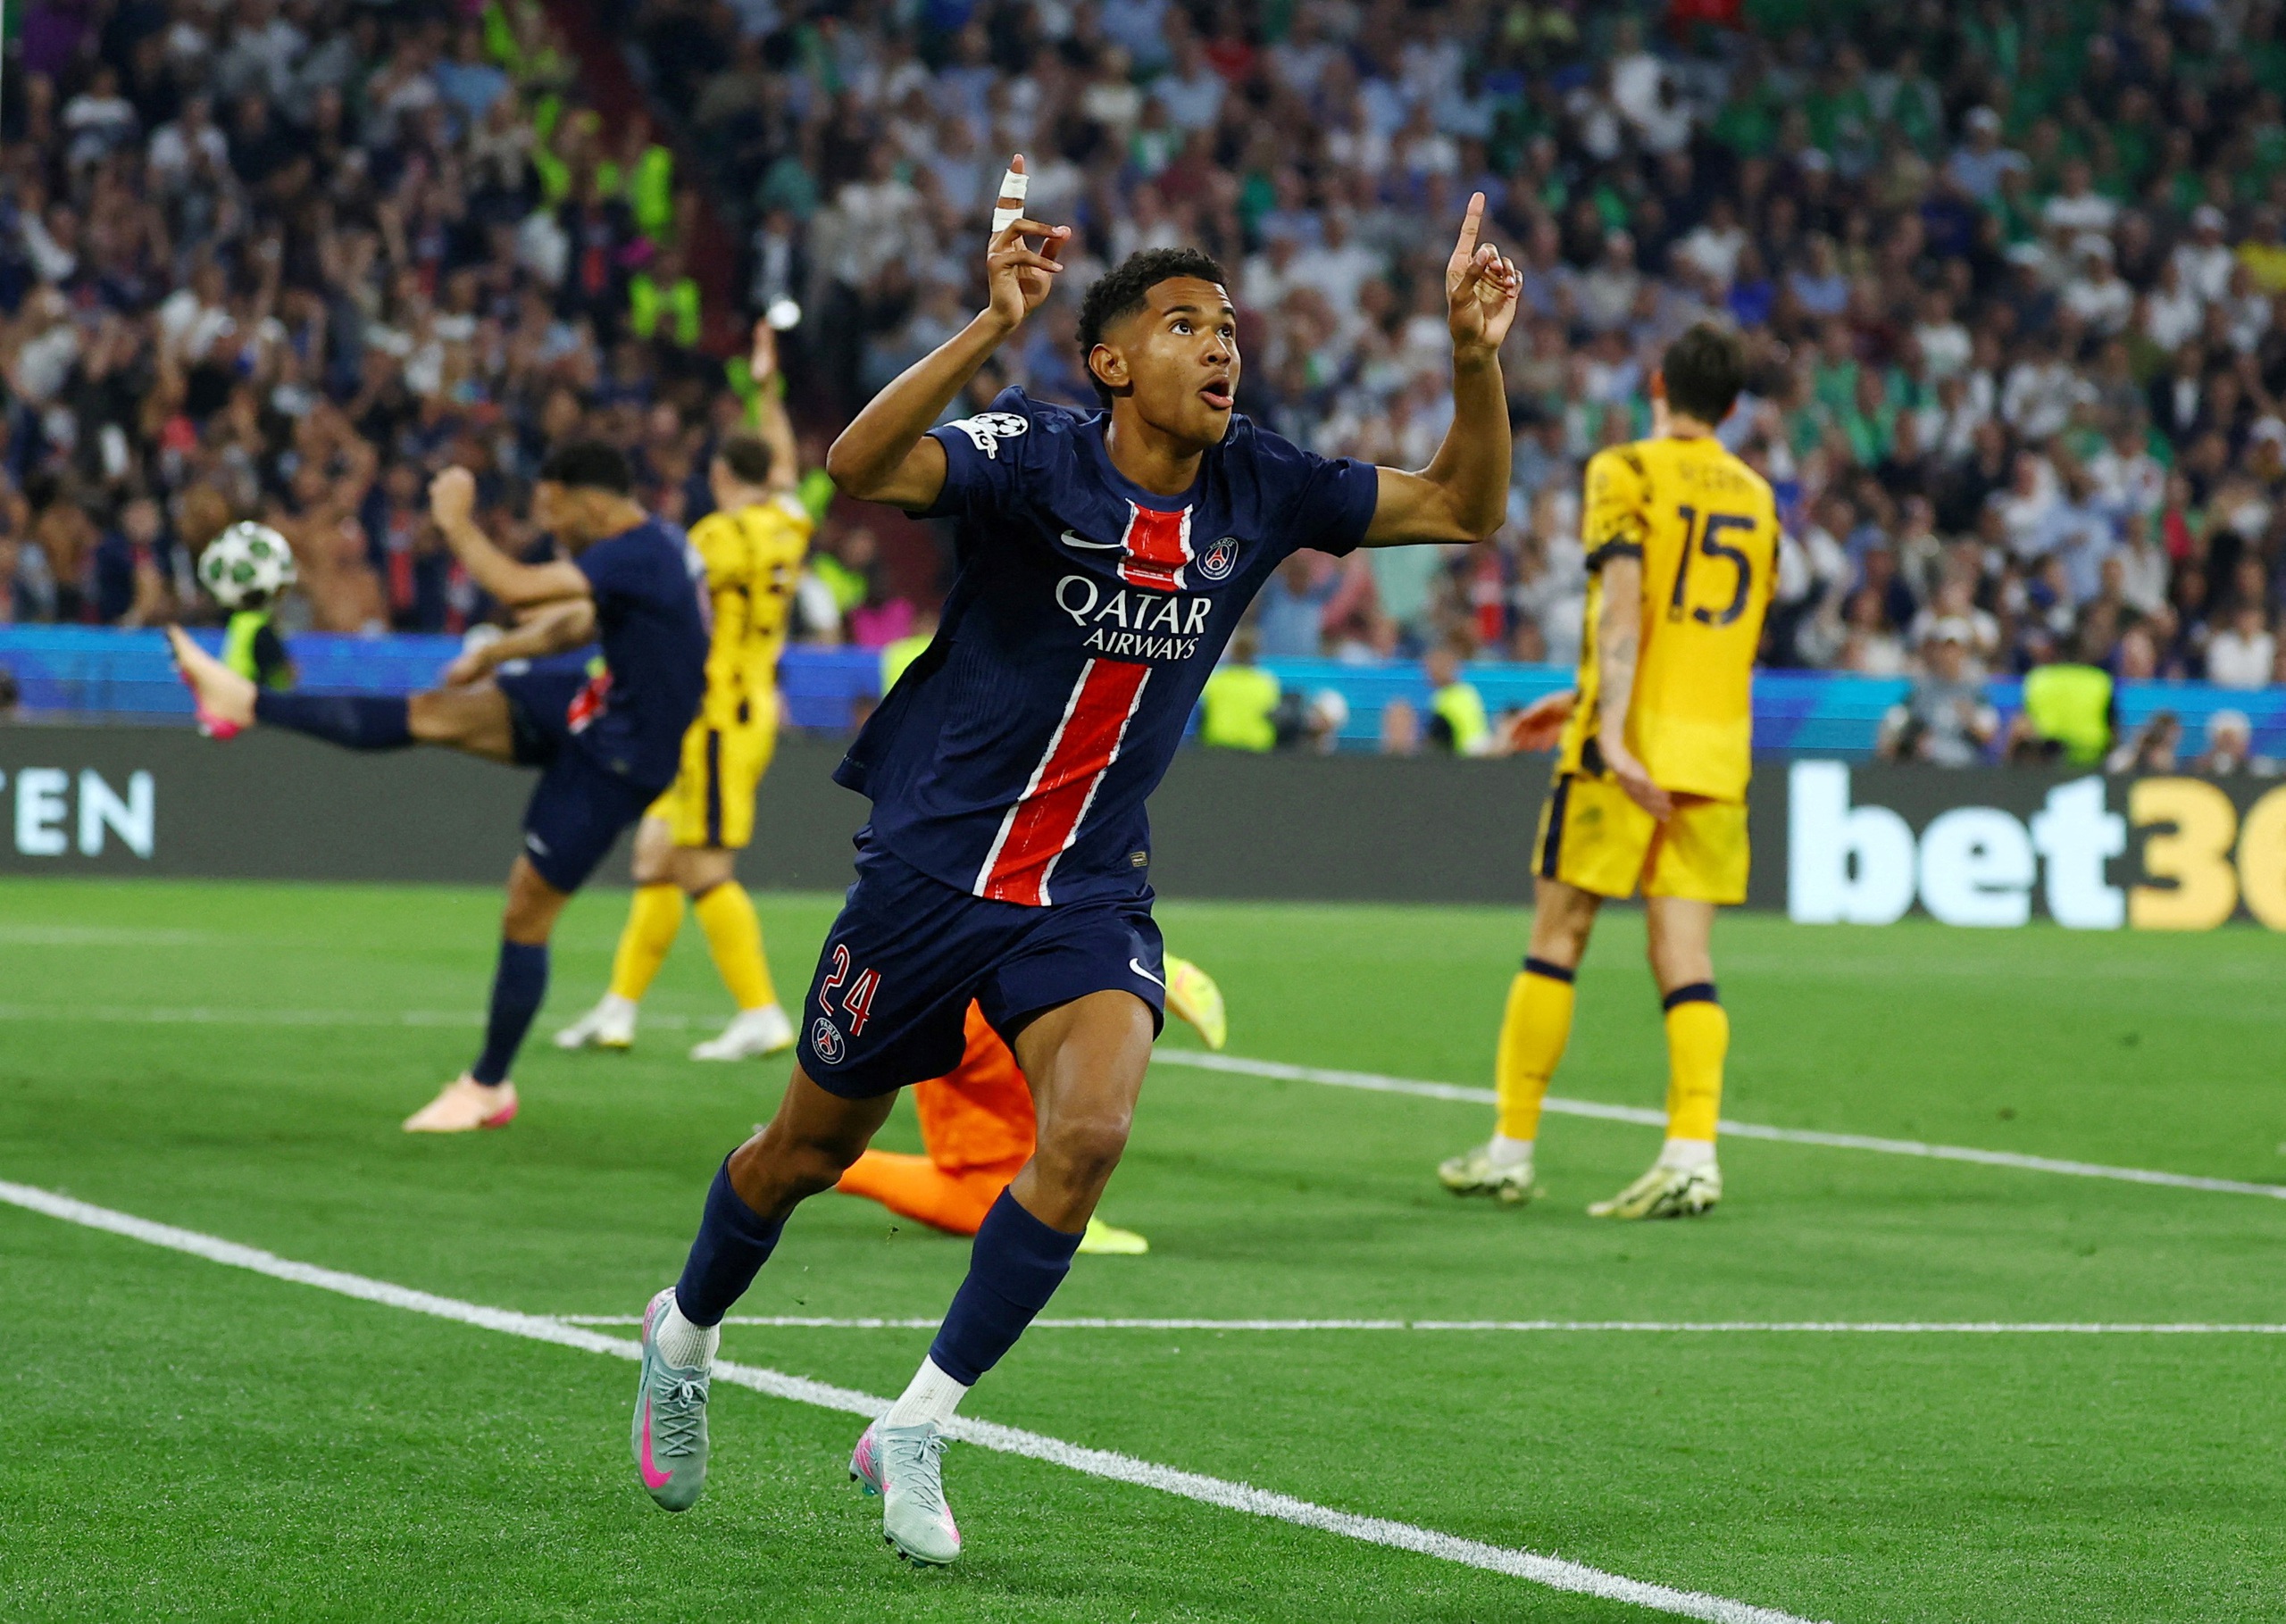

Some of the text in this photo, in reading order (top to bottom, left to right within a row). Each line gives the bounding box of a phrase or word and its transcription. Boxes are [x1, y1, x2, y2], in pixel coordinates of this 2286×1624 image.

[1055, 575, 1212, 635] QATAR
[1668, 504, 1756, 629] 15
[1082, 628, 1200, 661] AIRWAYS
[0, 765, 155, 861] EN
[818, 943, 881, 1037] 24
[820, 1020, 841, 1042] PARIS
